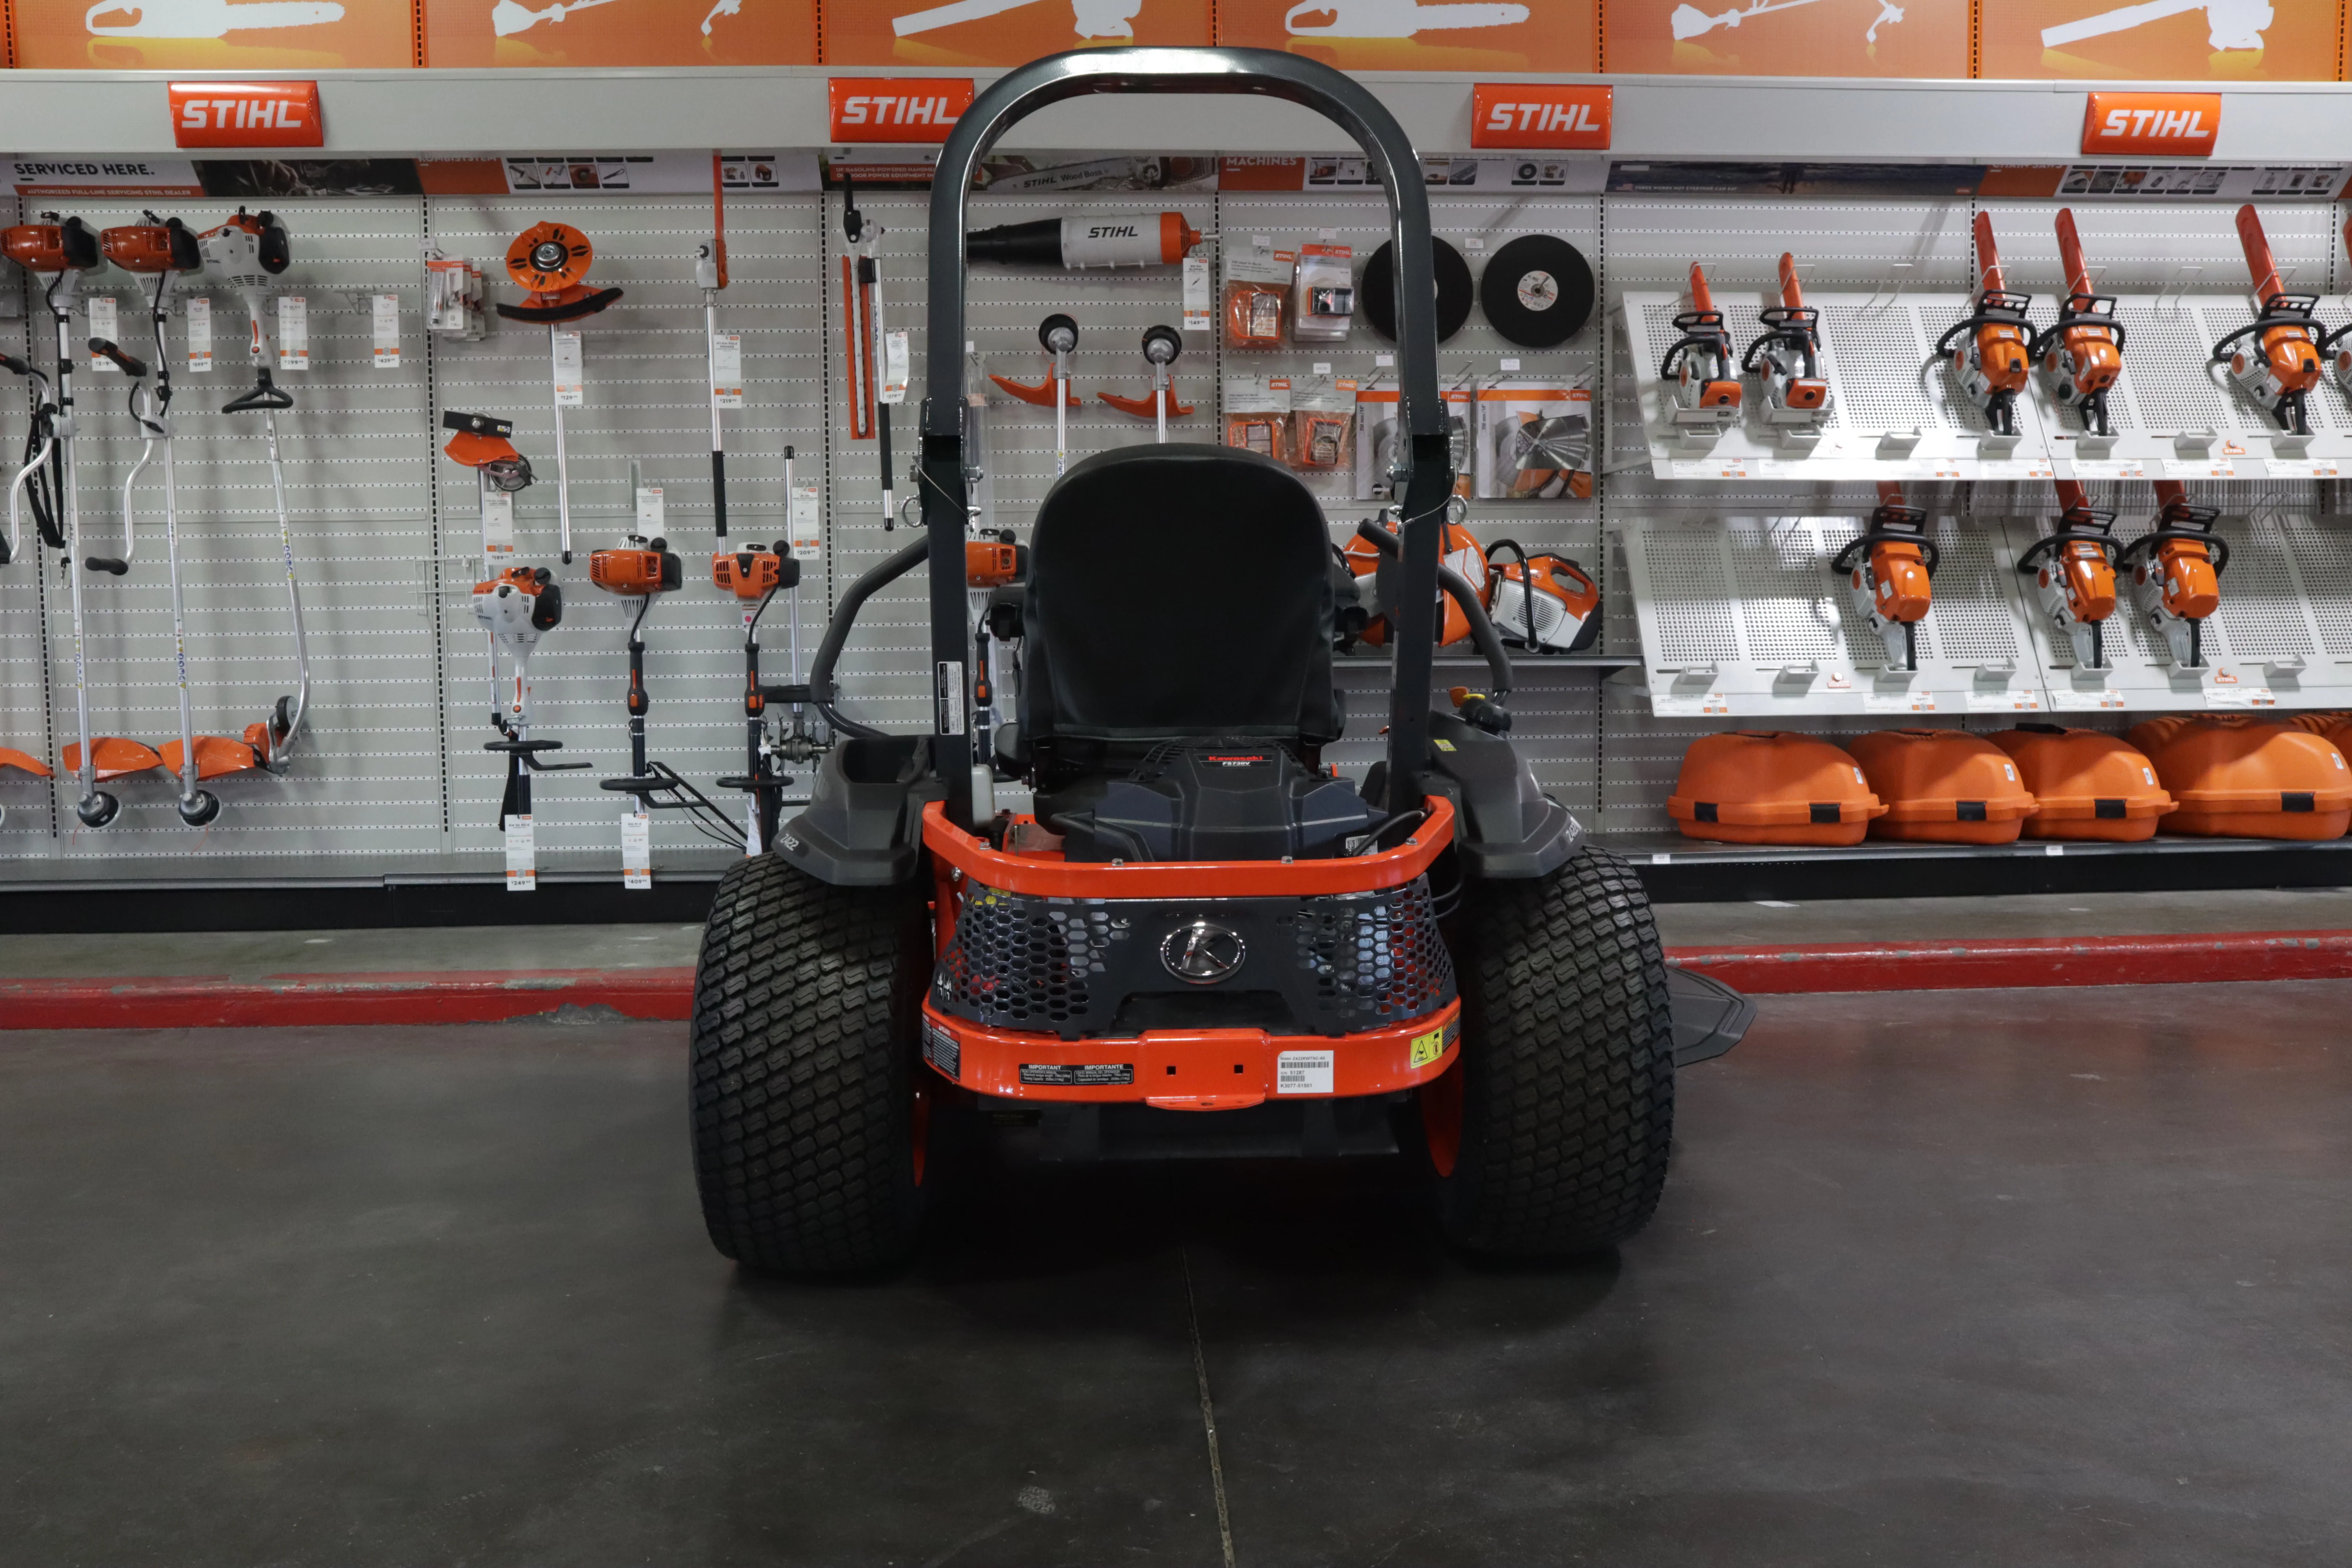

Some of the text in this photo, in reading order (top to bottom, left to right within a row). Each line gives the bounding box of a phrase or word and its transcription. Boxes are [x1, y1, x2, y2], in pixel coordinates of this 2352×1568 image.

[181, 100, 301, 128] STIHL
[841, 96, 959, 124] STIHL
[1486, 103, 1601, 131] STIHL
[2100, 109, 2210, 138] STIHL
[14, 164, 155, 175] SERVICED HERE.
[1226, 156, 1297, 165] MACHINES
[1024, 177, 1057, 188] STIHL
[1060, 173, 1082, 182] Wood
[1088, 226, 1138, 238] STIHL
[780, 833, 799, 851] Z422
